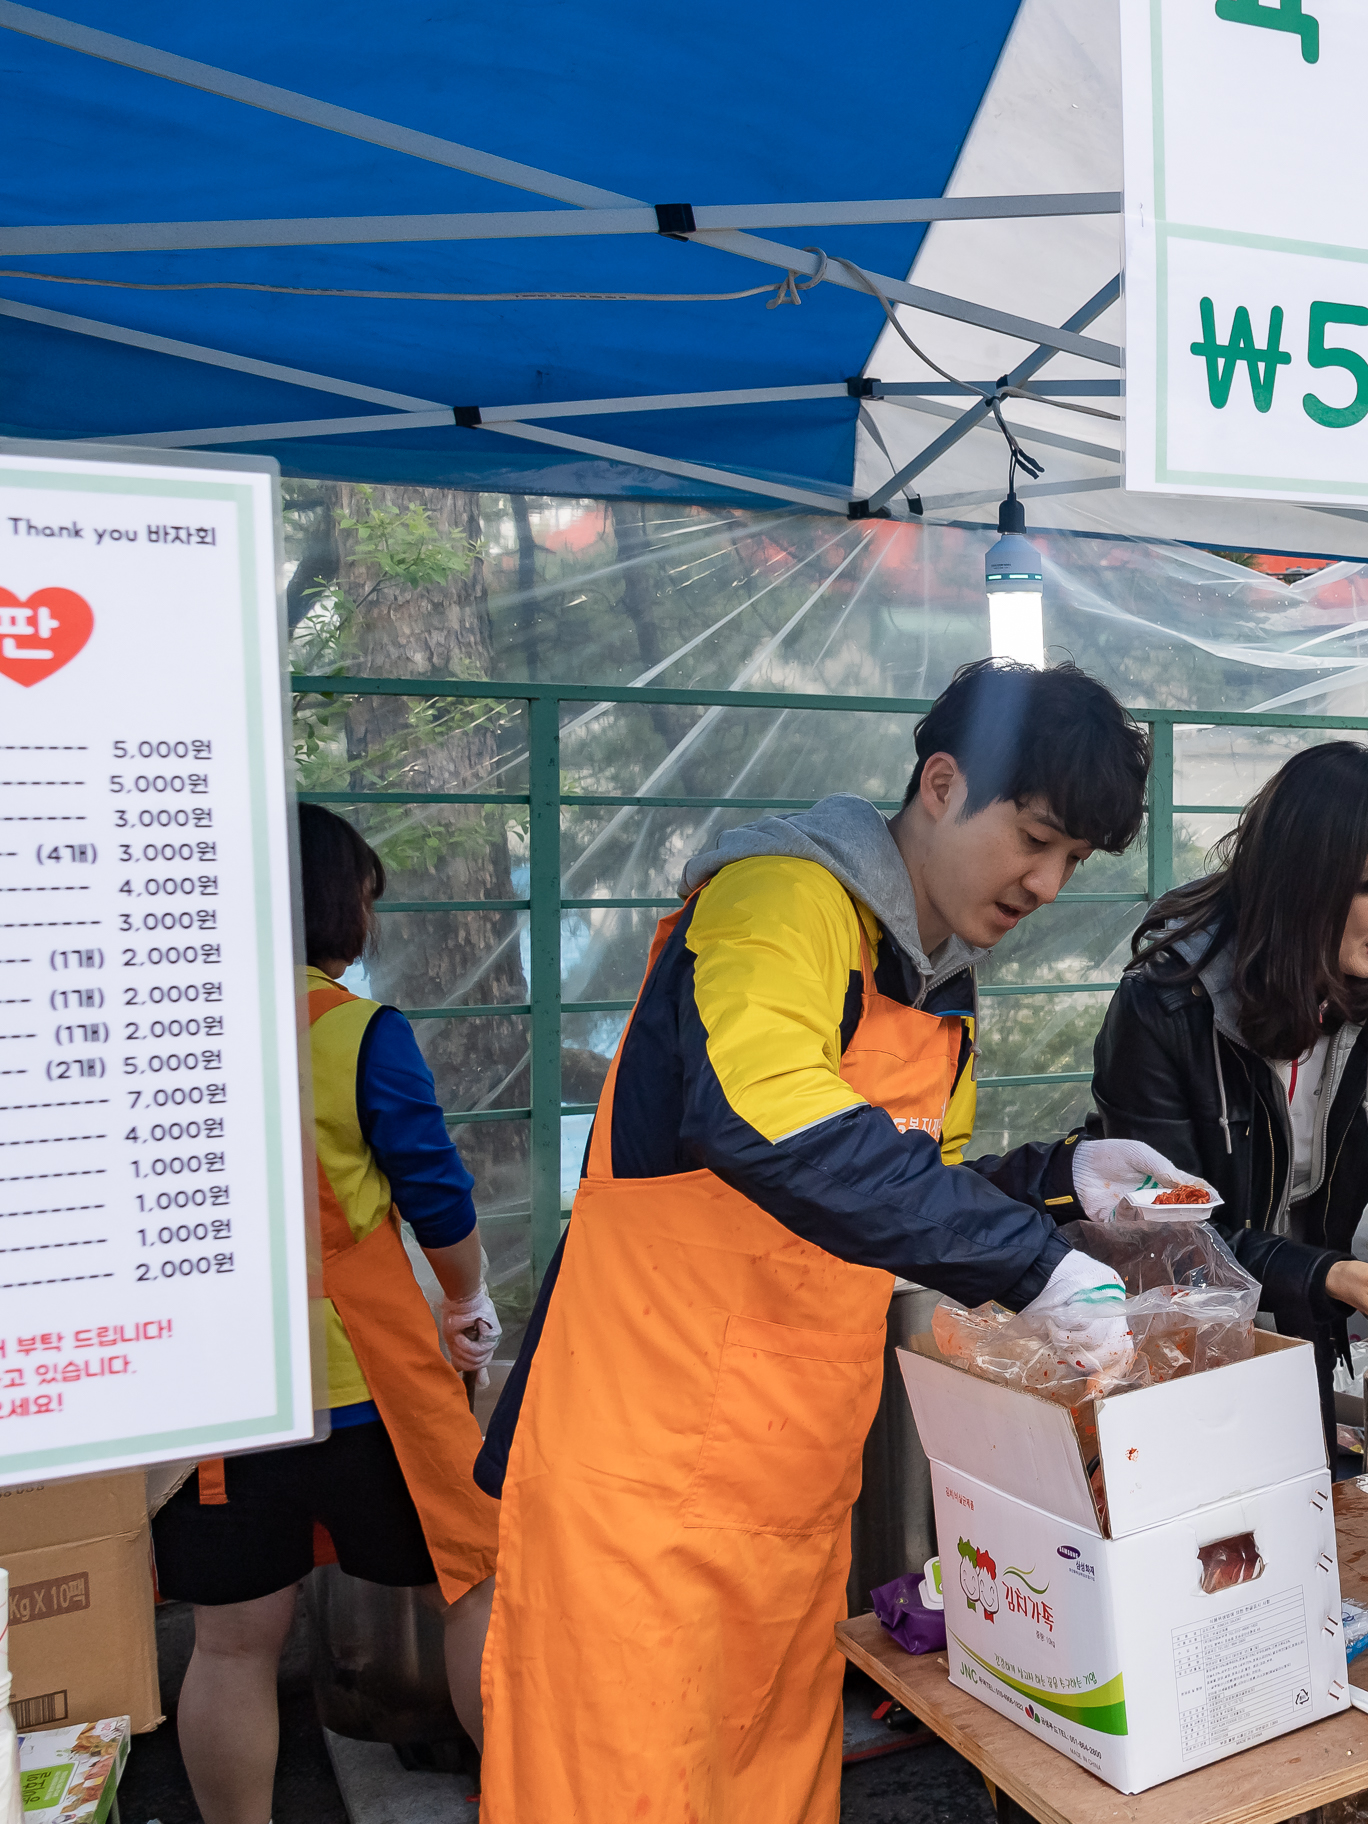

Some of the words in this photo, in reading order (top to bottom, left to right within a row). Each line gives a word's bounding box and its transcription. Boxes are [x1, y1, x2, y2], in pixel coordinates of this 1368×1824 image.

[8, 517, 84, 540] Thank
[94, 526, 138, 545] you
[147, 524, 217, 546] 바자회
[114, 740, 213, 760] 5,000원
[109, 774, 210, 794] 5,000원
[114, 808, 213, 829] 3,000원
[36, 844, 98, 865] (4개)
[118, 841, 218, 862] 3,000원
[119, 875, 219, 897] 4,000원
[118, 909, 218, 931] 3,000원
[50, 948, 105, 971] (1개)
[122, 943, 222, 967] 2,000원
[50, 987, 105, 1011] (1개)
[123, 982, 223, 1006] 2,000원
[54, 1022, 110, 1045] (1개)
[124, 1015, 225, 1041] 2,000원
[46, 1057, 106, 1081] (2개)
[122, 1049, 223, 1075] 5,000원
[127, 1083, 227, 1110] 7,000원
[124, 1118, 225, 1144] 4,000원
[130, 1152, 226, 1179] 1,000원
[135, 1185, 231, 1213] 1,000원
[137, 1219, 233, 1247] 1,000원
[135, 1252, 235, 1282] 2,000원
[16, 1332, 65, 1356] 부탁
[73, 1318, 173, 1348] 드립니다!
[0, 1368, 26, 1389] 고
[35, 1354, 138, 1386] 있습니다.
[1001, 1580, 1055, 1632] 김치가족
[959, 1661, 979, 1685] JNC
